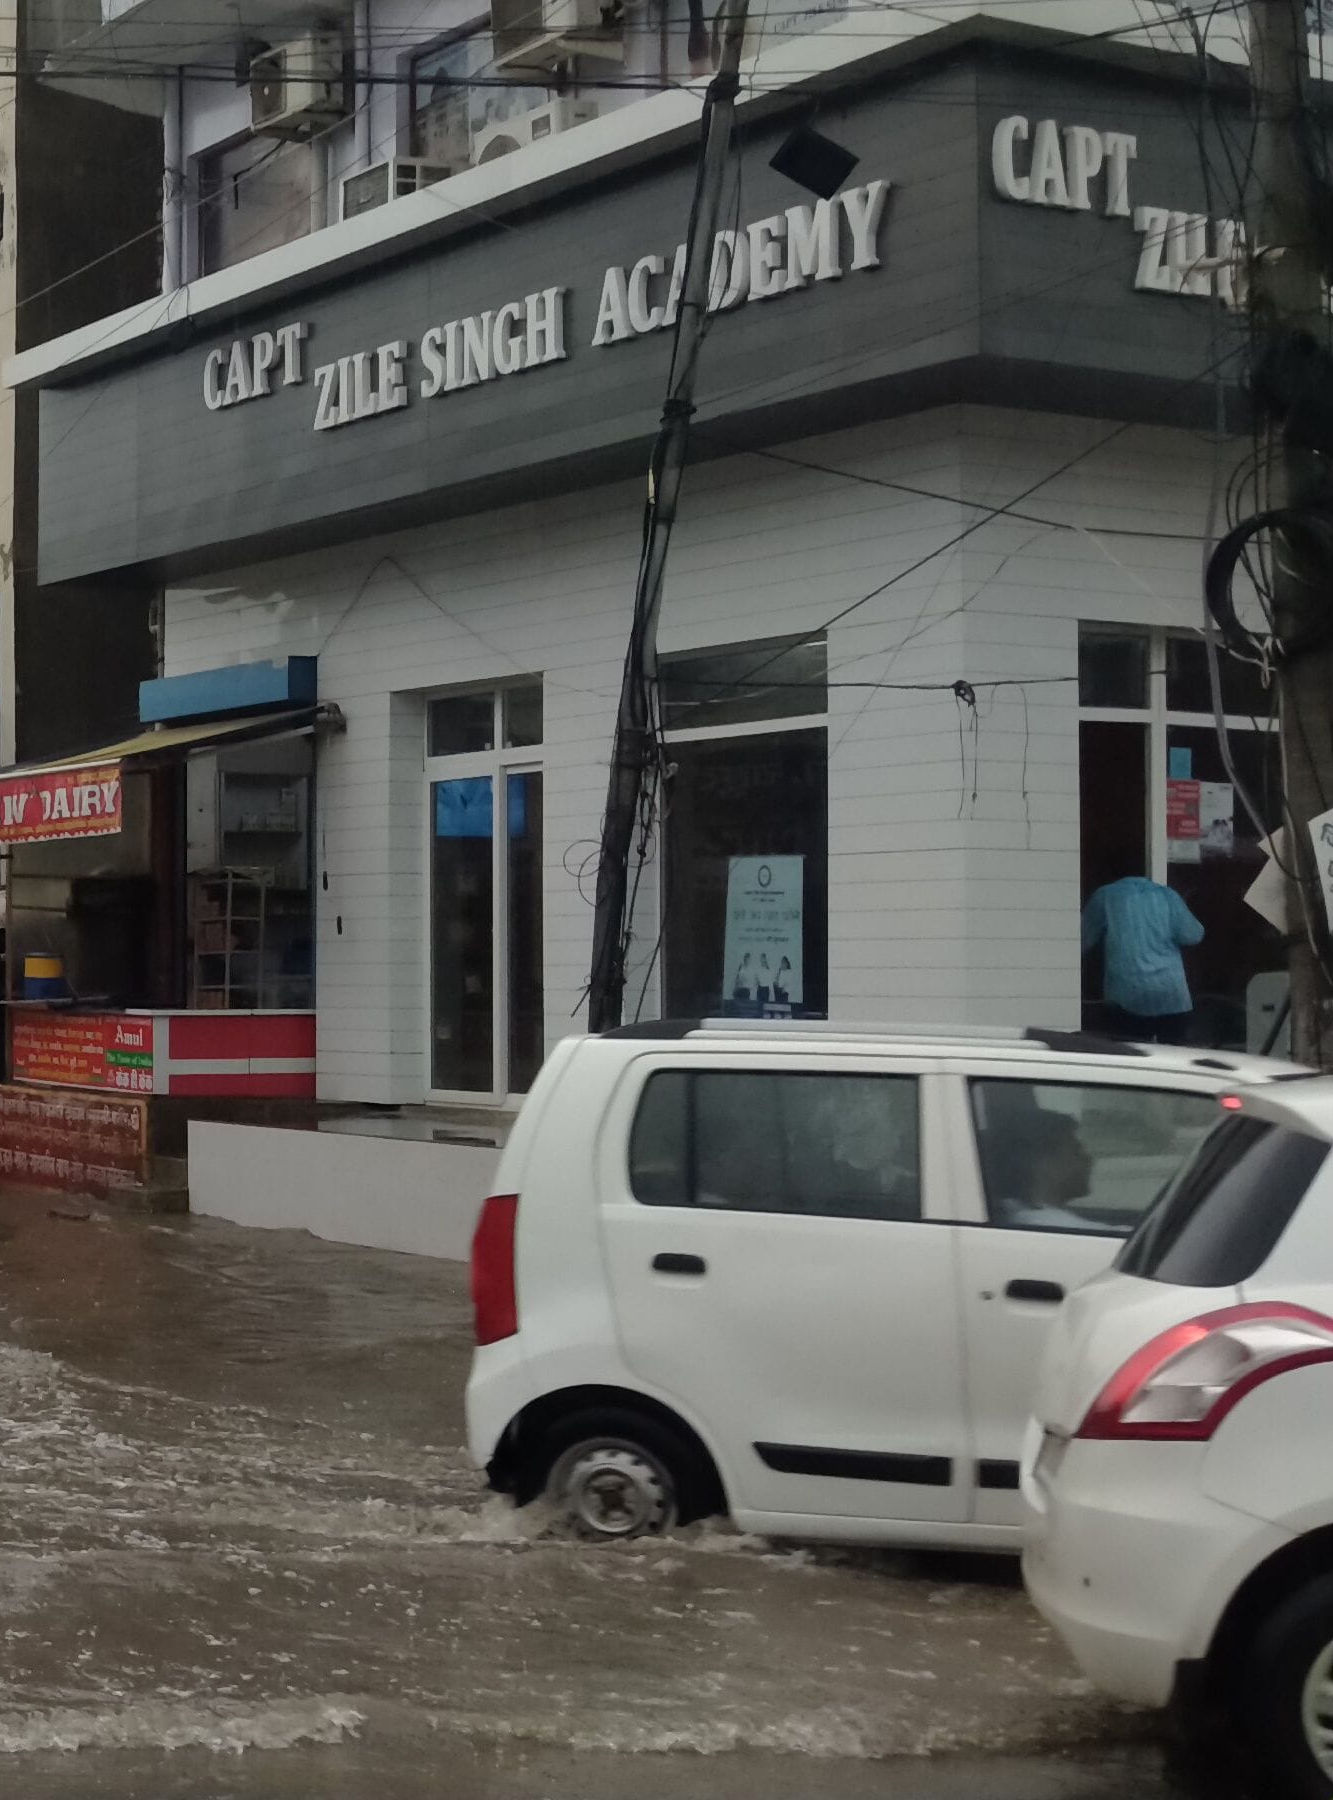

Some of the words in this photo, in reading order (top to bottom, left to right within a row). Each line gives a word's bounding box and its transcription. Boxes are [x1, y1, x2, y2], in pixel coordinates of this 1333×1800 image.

[991, 114, 1139, 217] CAPT
[201, 320, 311, 412] CAPT
[311, 339, 411, 432] ZILE
[419, 285, 568, 399] SINGH
[590, 179, 893, 347] ACADEMY
[115, 1024, 144, 1047] Amul
